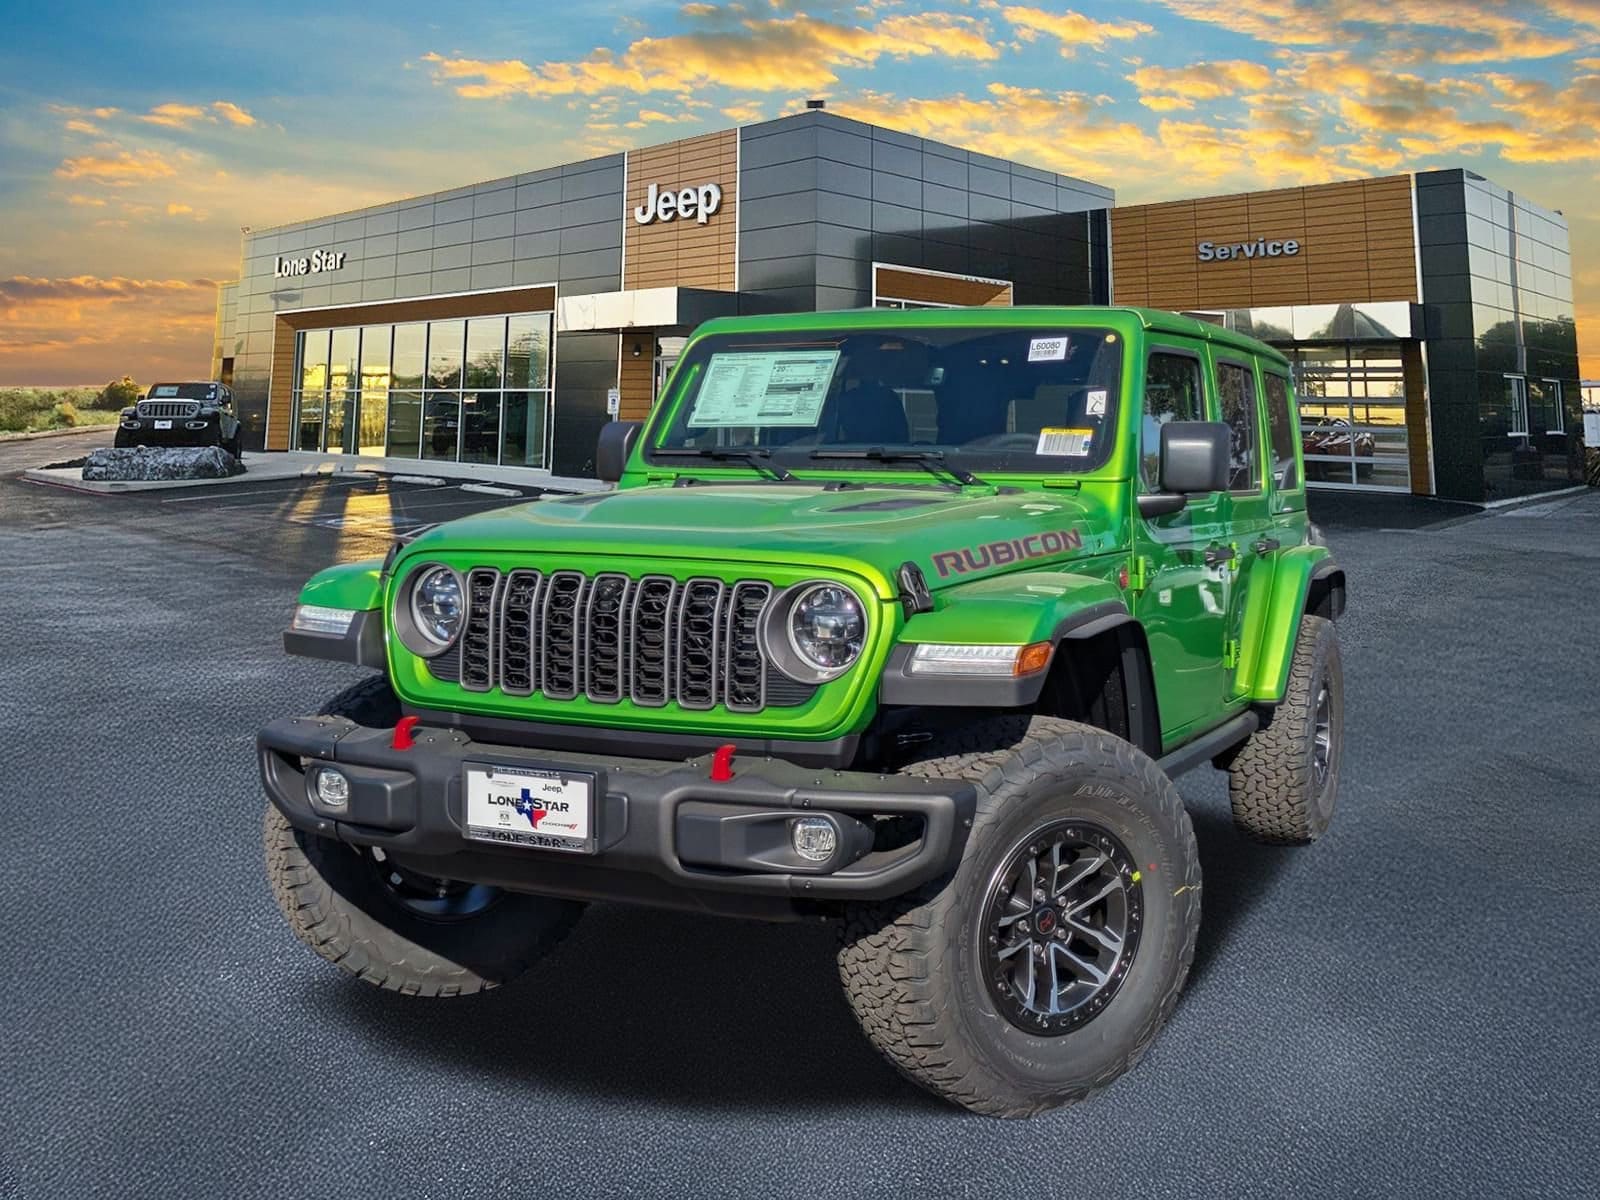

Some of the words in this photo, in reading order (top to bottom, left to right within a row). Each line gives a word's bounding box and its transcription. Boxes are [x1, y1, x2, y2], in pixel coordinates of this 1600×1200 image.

[634, 183, 722, 224] Jeep
[1198, 237, 1300, 261] Service
[275, 257, 310, 278] Lone
[311, 249, 346, 273] Star
[931, 527, 1082, 578] RUBICON
[542, 783, 563, 794] Jeep
[487, 793, 522, 808] LONE
[532, 797, 569, 813] STAR
